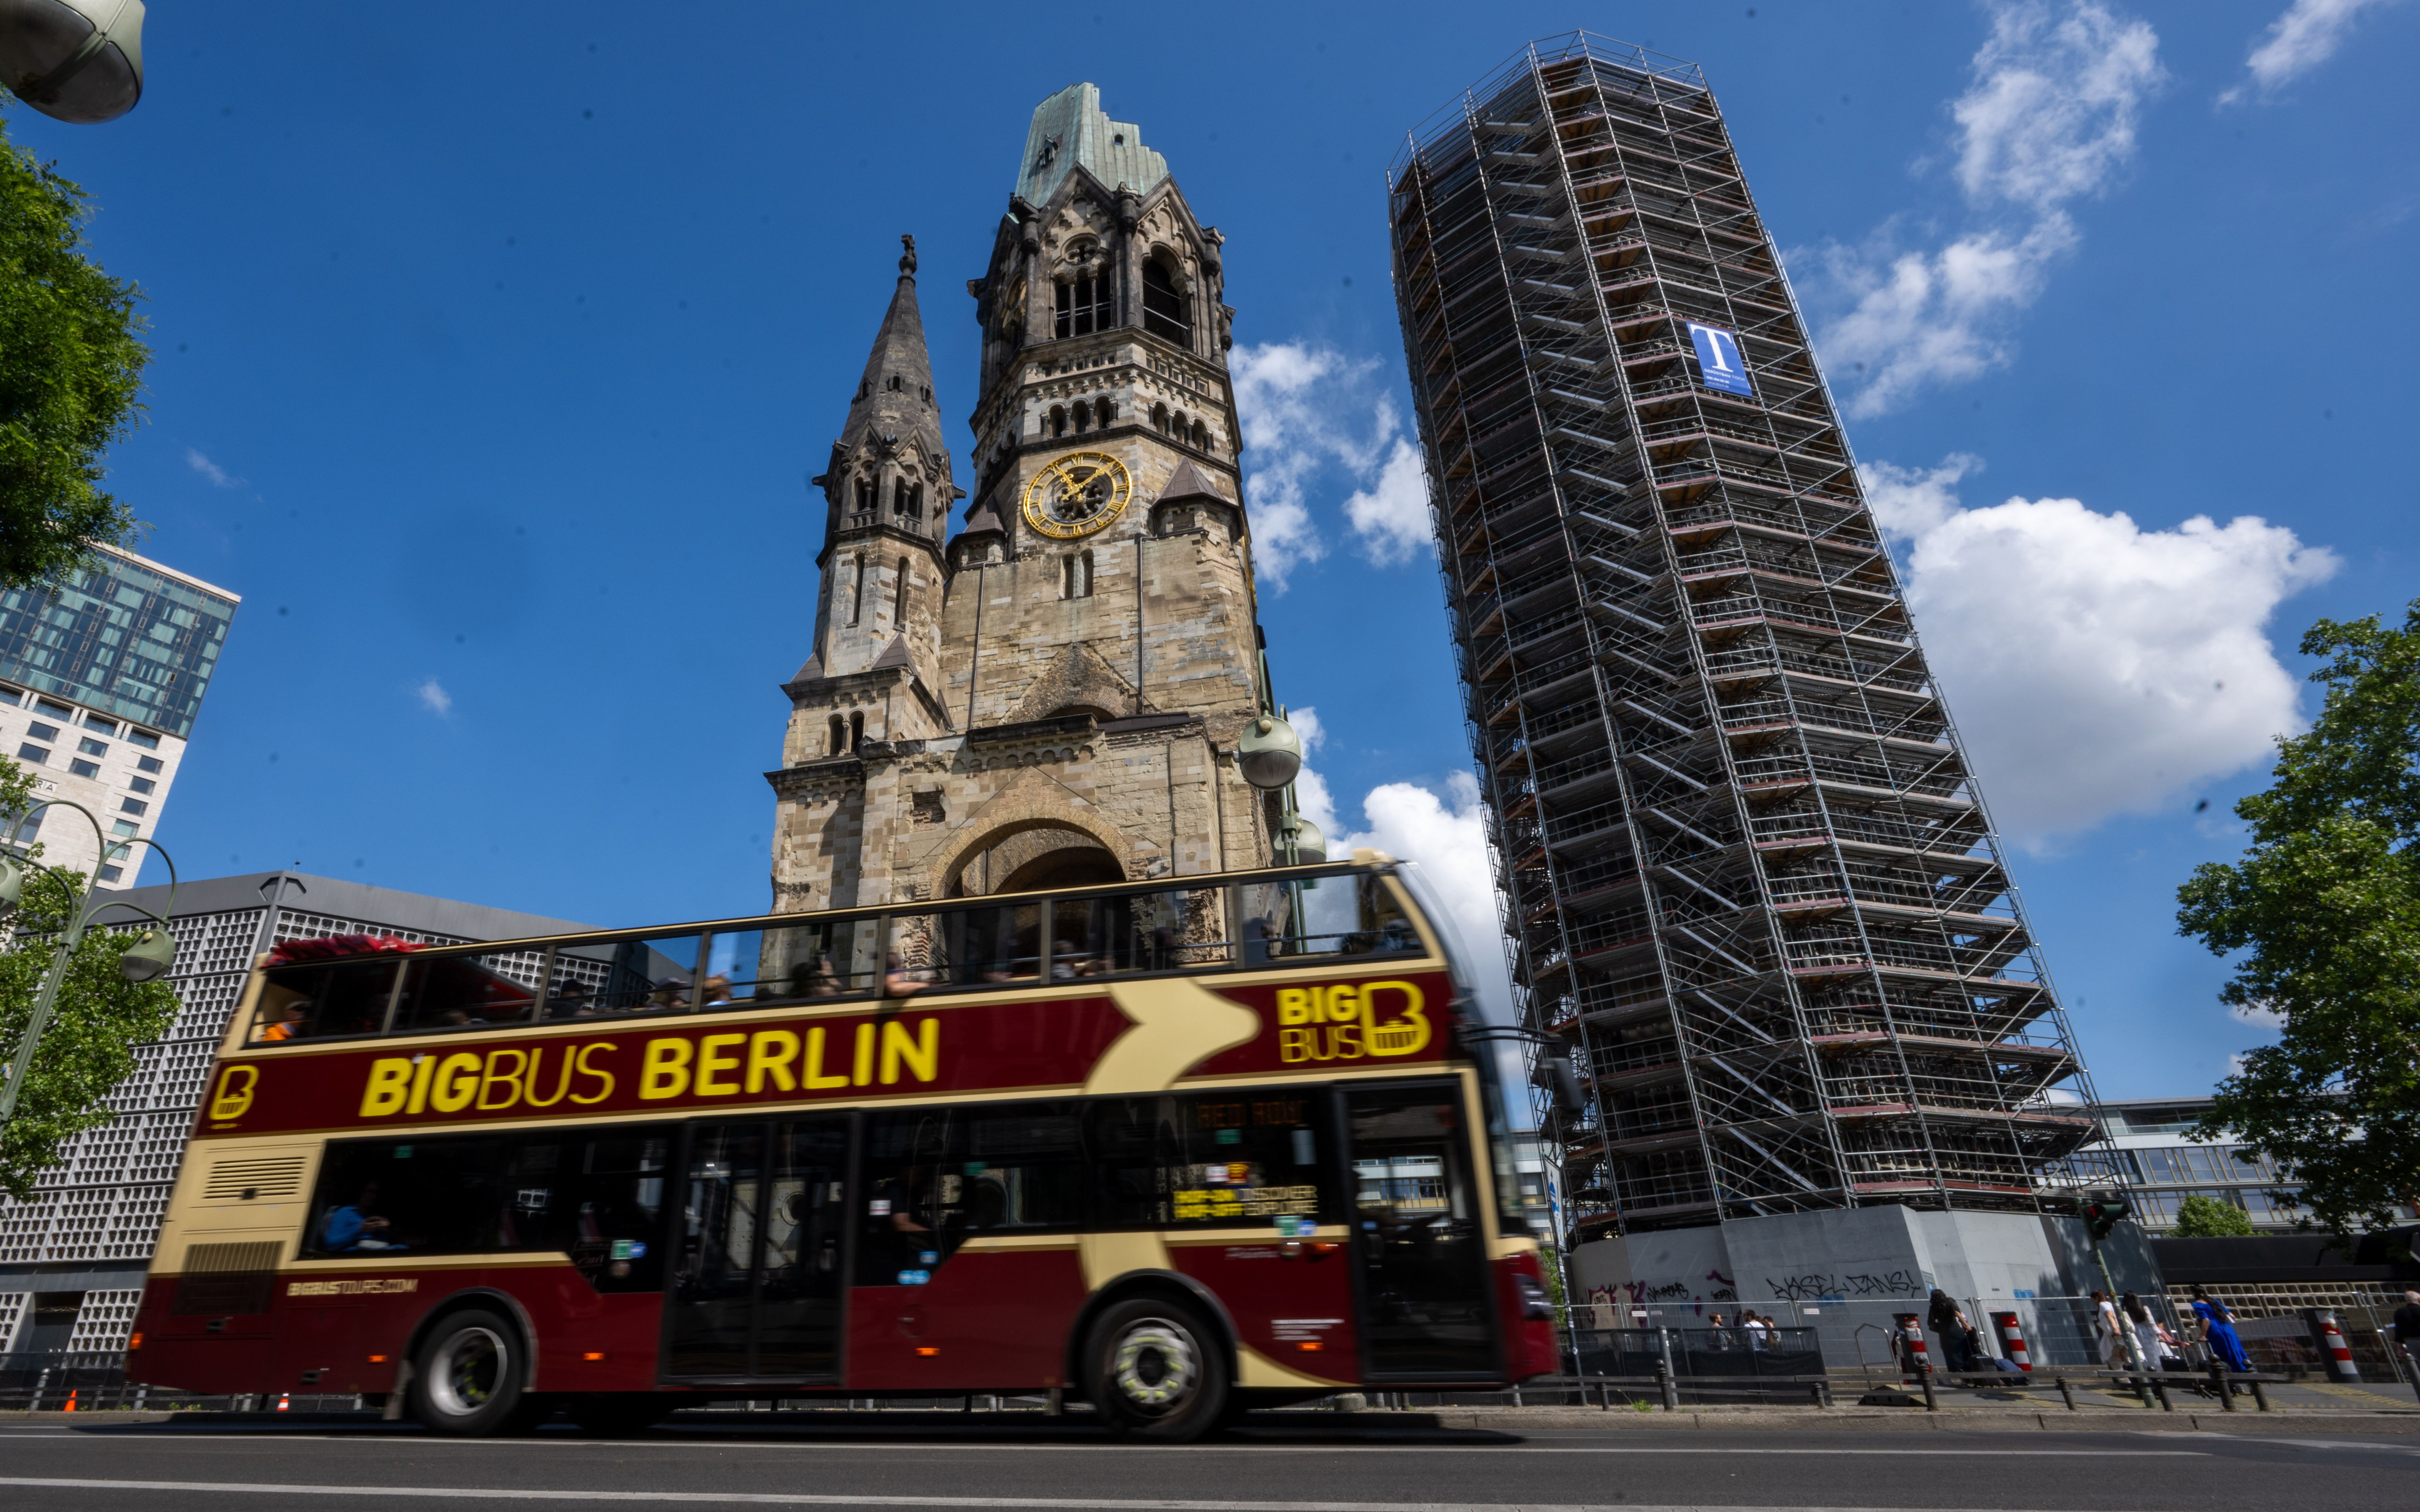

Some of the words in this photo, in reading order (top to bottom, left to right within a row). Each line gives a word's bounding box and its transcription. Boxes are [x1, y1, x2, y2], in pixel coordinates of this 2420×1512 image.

[1690, 324, 1734, 372] T
[1276, 985, 1361, 1025] BIG
[638, 1018, 940, 1100] BERLIN
[1279, 1025, 1366, 1063] BUS
